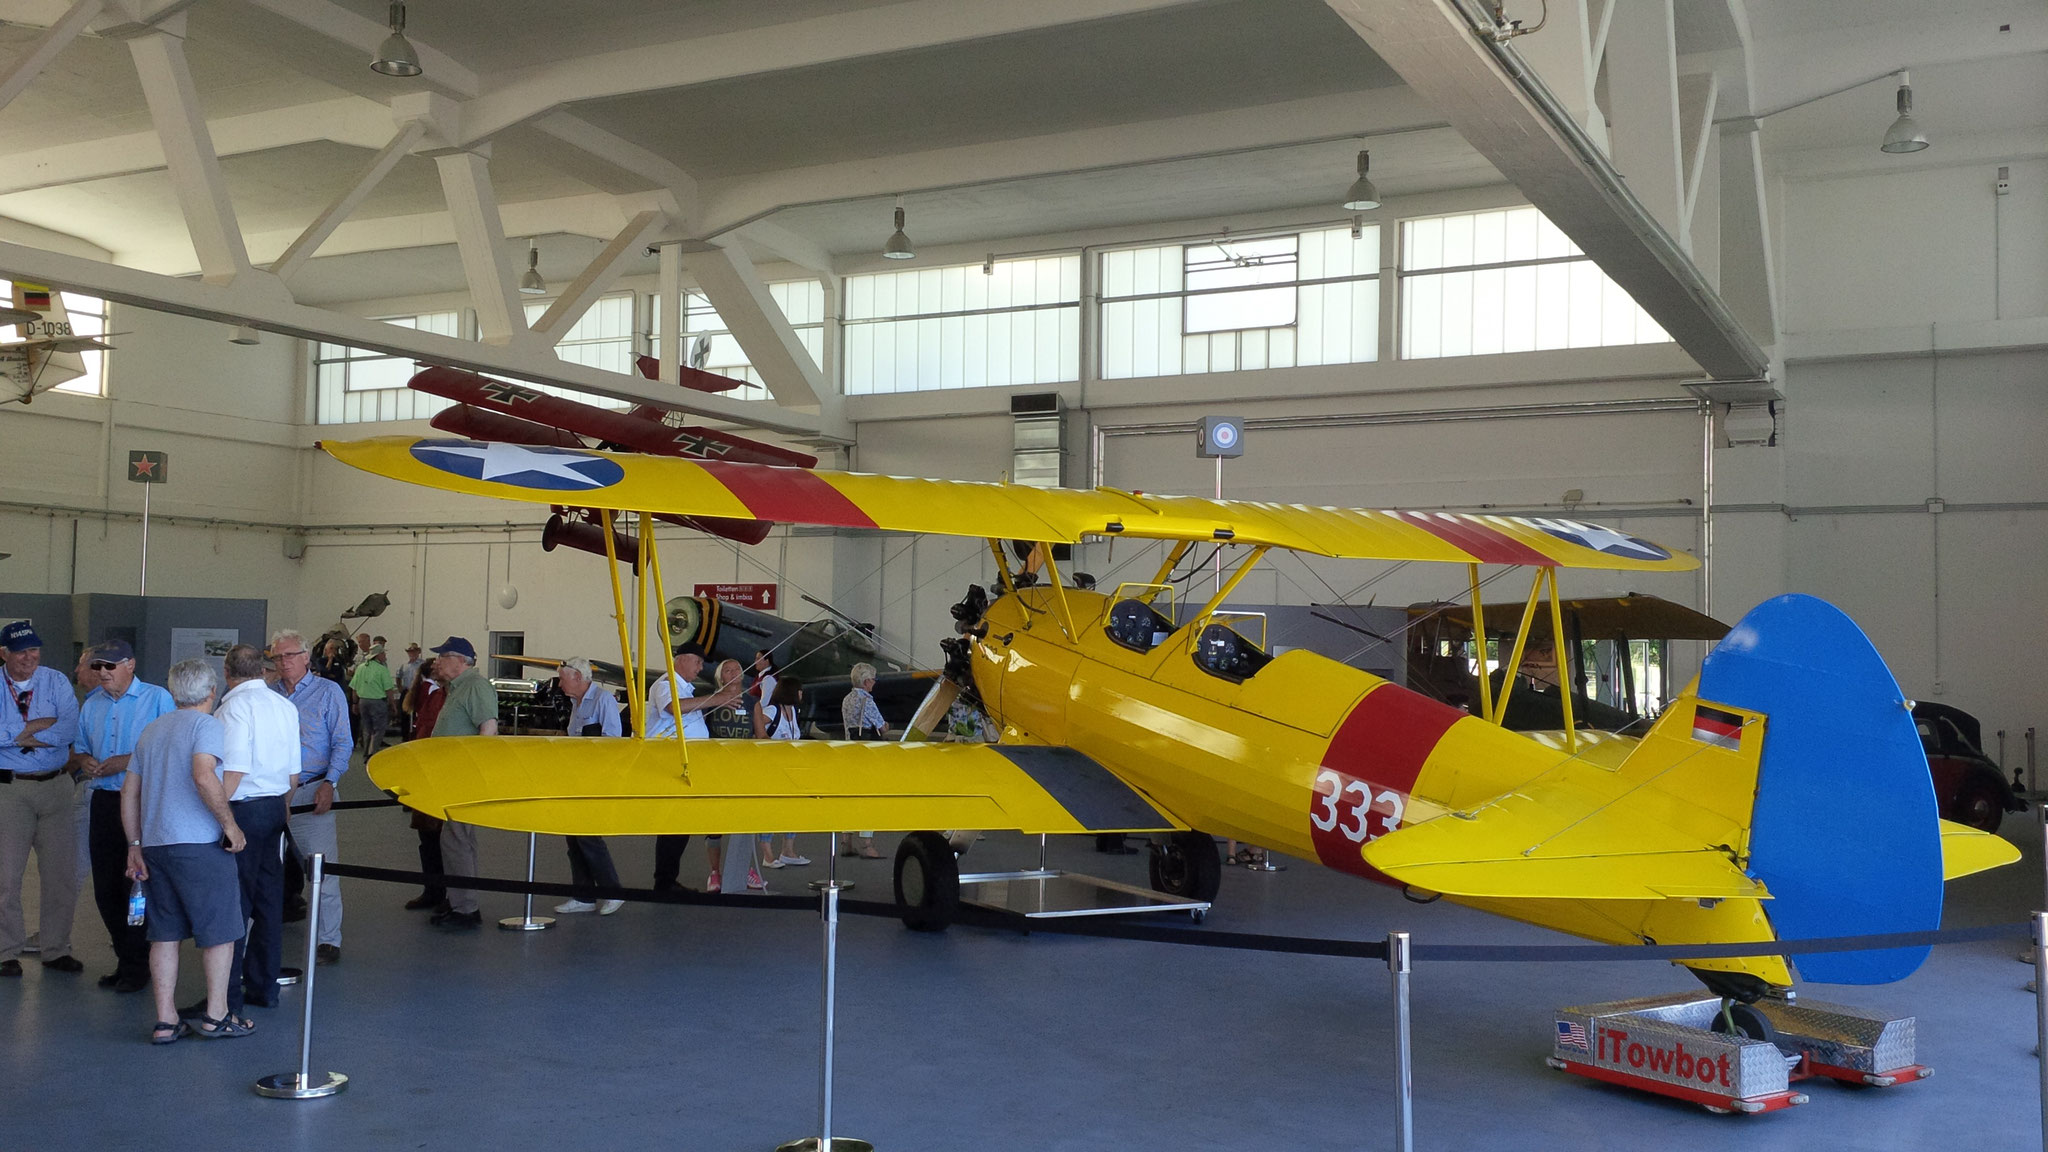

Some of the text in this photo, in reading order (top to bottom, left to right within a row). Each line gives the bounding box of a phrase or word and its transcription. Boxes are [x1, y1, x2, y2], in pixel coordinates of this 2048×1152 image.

[26, 321, 72, 336] D-1038
[713, 708, 750, 724] LOVE
[1597, 1027, 1732, 1088] iTowbot
